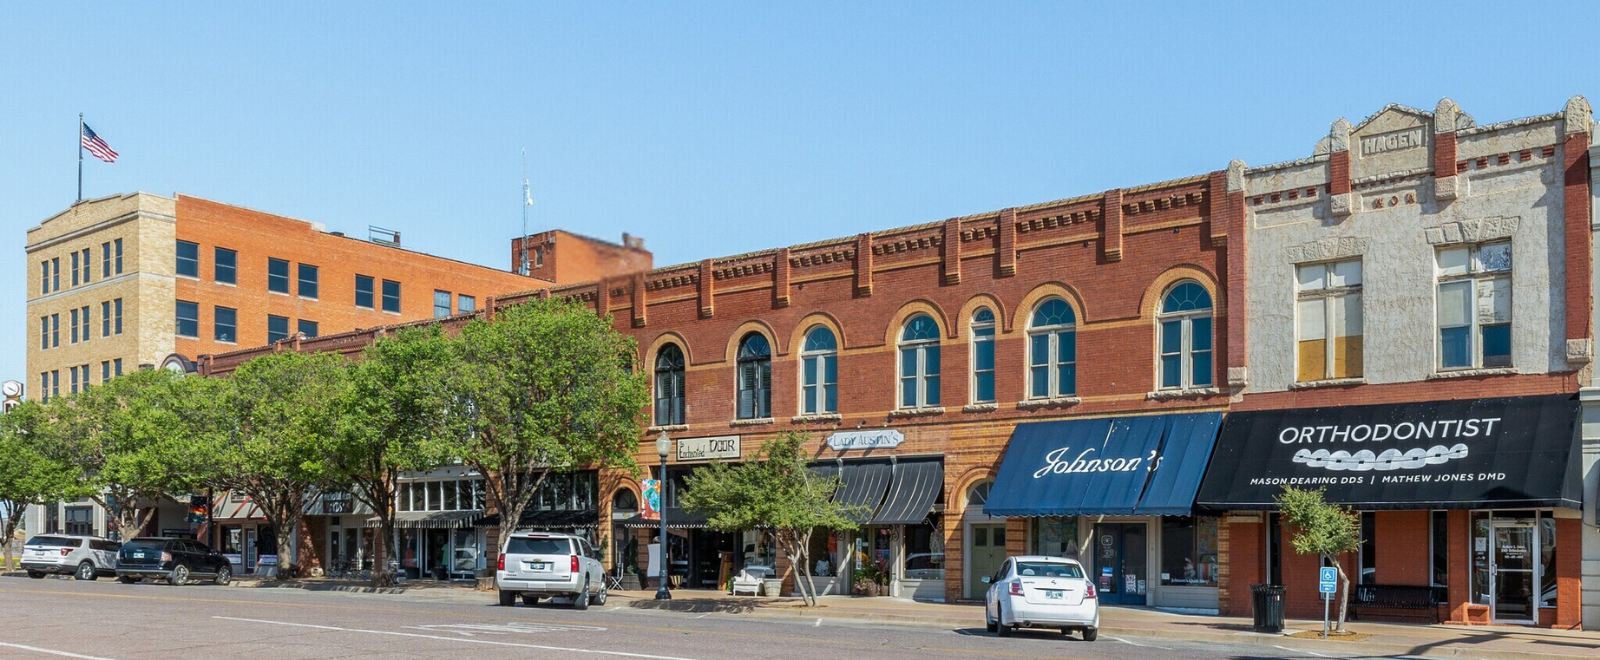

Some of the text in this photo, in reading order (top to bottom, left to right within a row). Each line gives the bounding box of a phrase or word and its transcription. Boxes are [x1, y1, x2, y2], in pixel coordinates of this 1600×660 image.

[1364, 129, 1422, 155] HAGEN
[834, 431, 899, 447] LADY AUSTIN'S
[1279, 418, 1501, 444] ORTHODONTIST
[1033, 447, 1164, 479] Johnson's
[1250, 477, 1288, 485] MASON
[1290, 476, 1337, 485] DEARING
[1340, 476, 1364, 484] DDS
[1382, 474, 1432, 484] MATHEW
[1434, 473, 1474, 483] JONES
[1478, 472, 1506, 481] DMD
